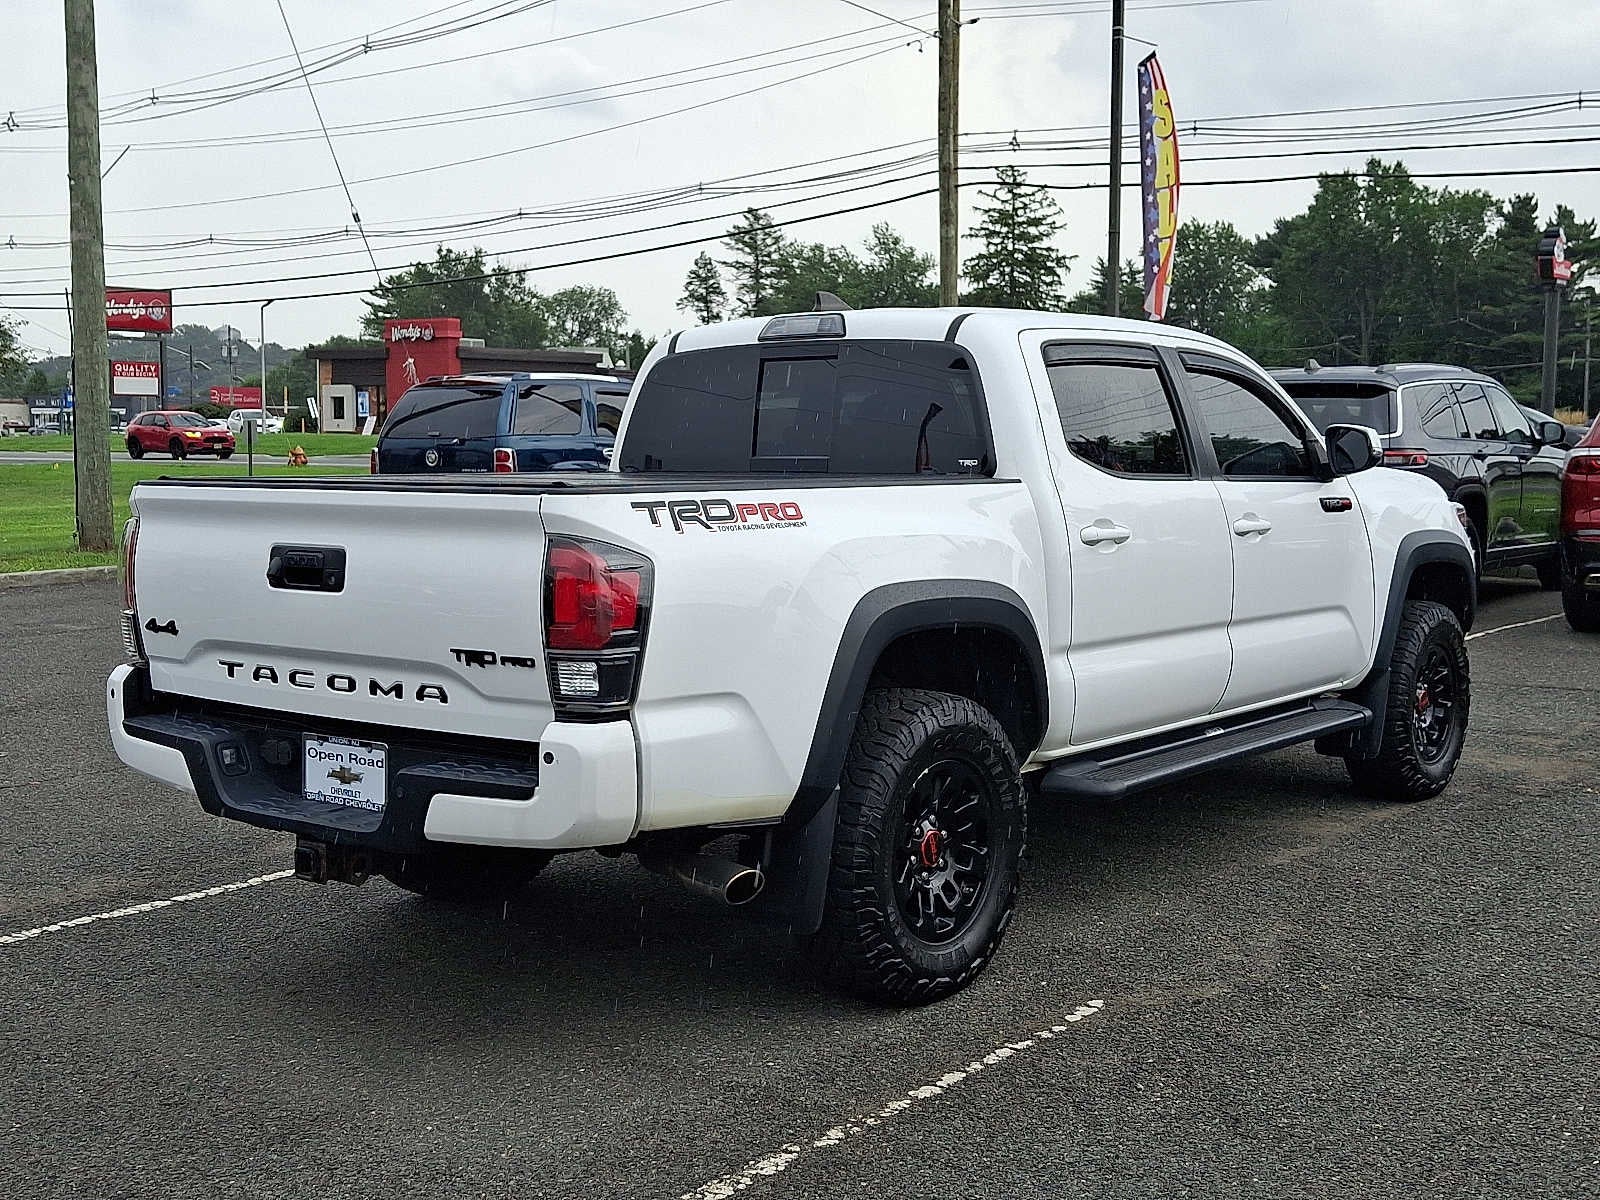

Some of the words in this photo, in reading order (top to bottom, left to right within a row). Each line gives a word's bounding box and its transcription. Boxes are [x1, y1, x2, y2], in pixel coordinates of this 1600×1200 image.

[391, 323, 421, 342] Wendy's
[114, 363, 156, 372] QUALITY
[958, 459, 978, 467] TRD
[630, 498, 737, 534] TRD
[735, 502, 804, 523] PRO
[717, 523, 743, 533] TOYOTA
[743, 522, 766, 532] RACING
[766, 521, 808, 530] DEVELOPMENT
[449, 648, 498, 668] TRD
[218, 659, 449, 704] TACOMA
[307, 747, 344, 763] Open
[348, 752, 385, 769] Road
[306, 792, 325, 801] OPEN
[325, 796, 344, 805] ROAD
[345, 799, 383, 812] CHEVROLET
[330, 786, 362, 799] CHEVROLET
